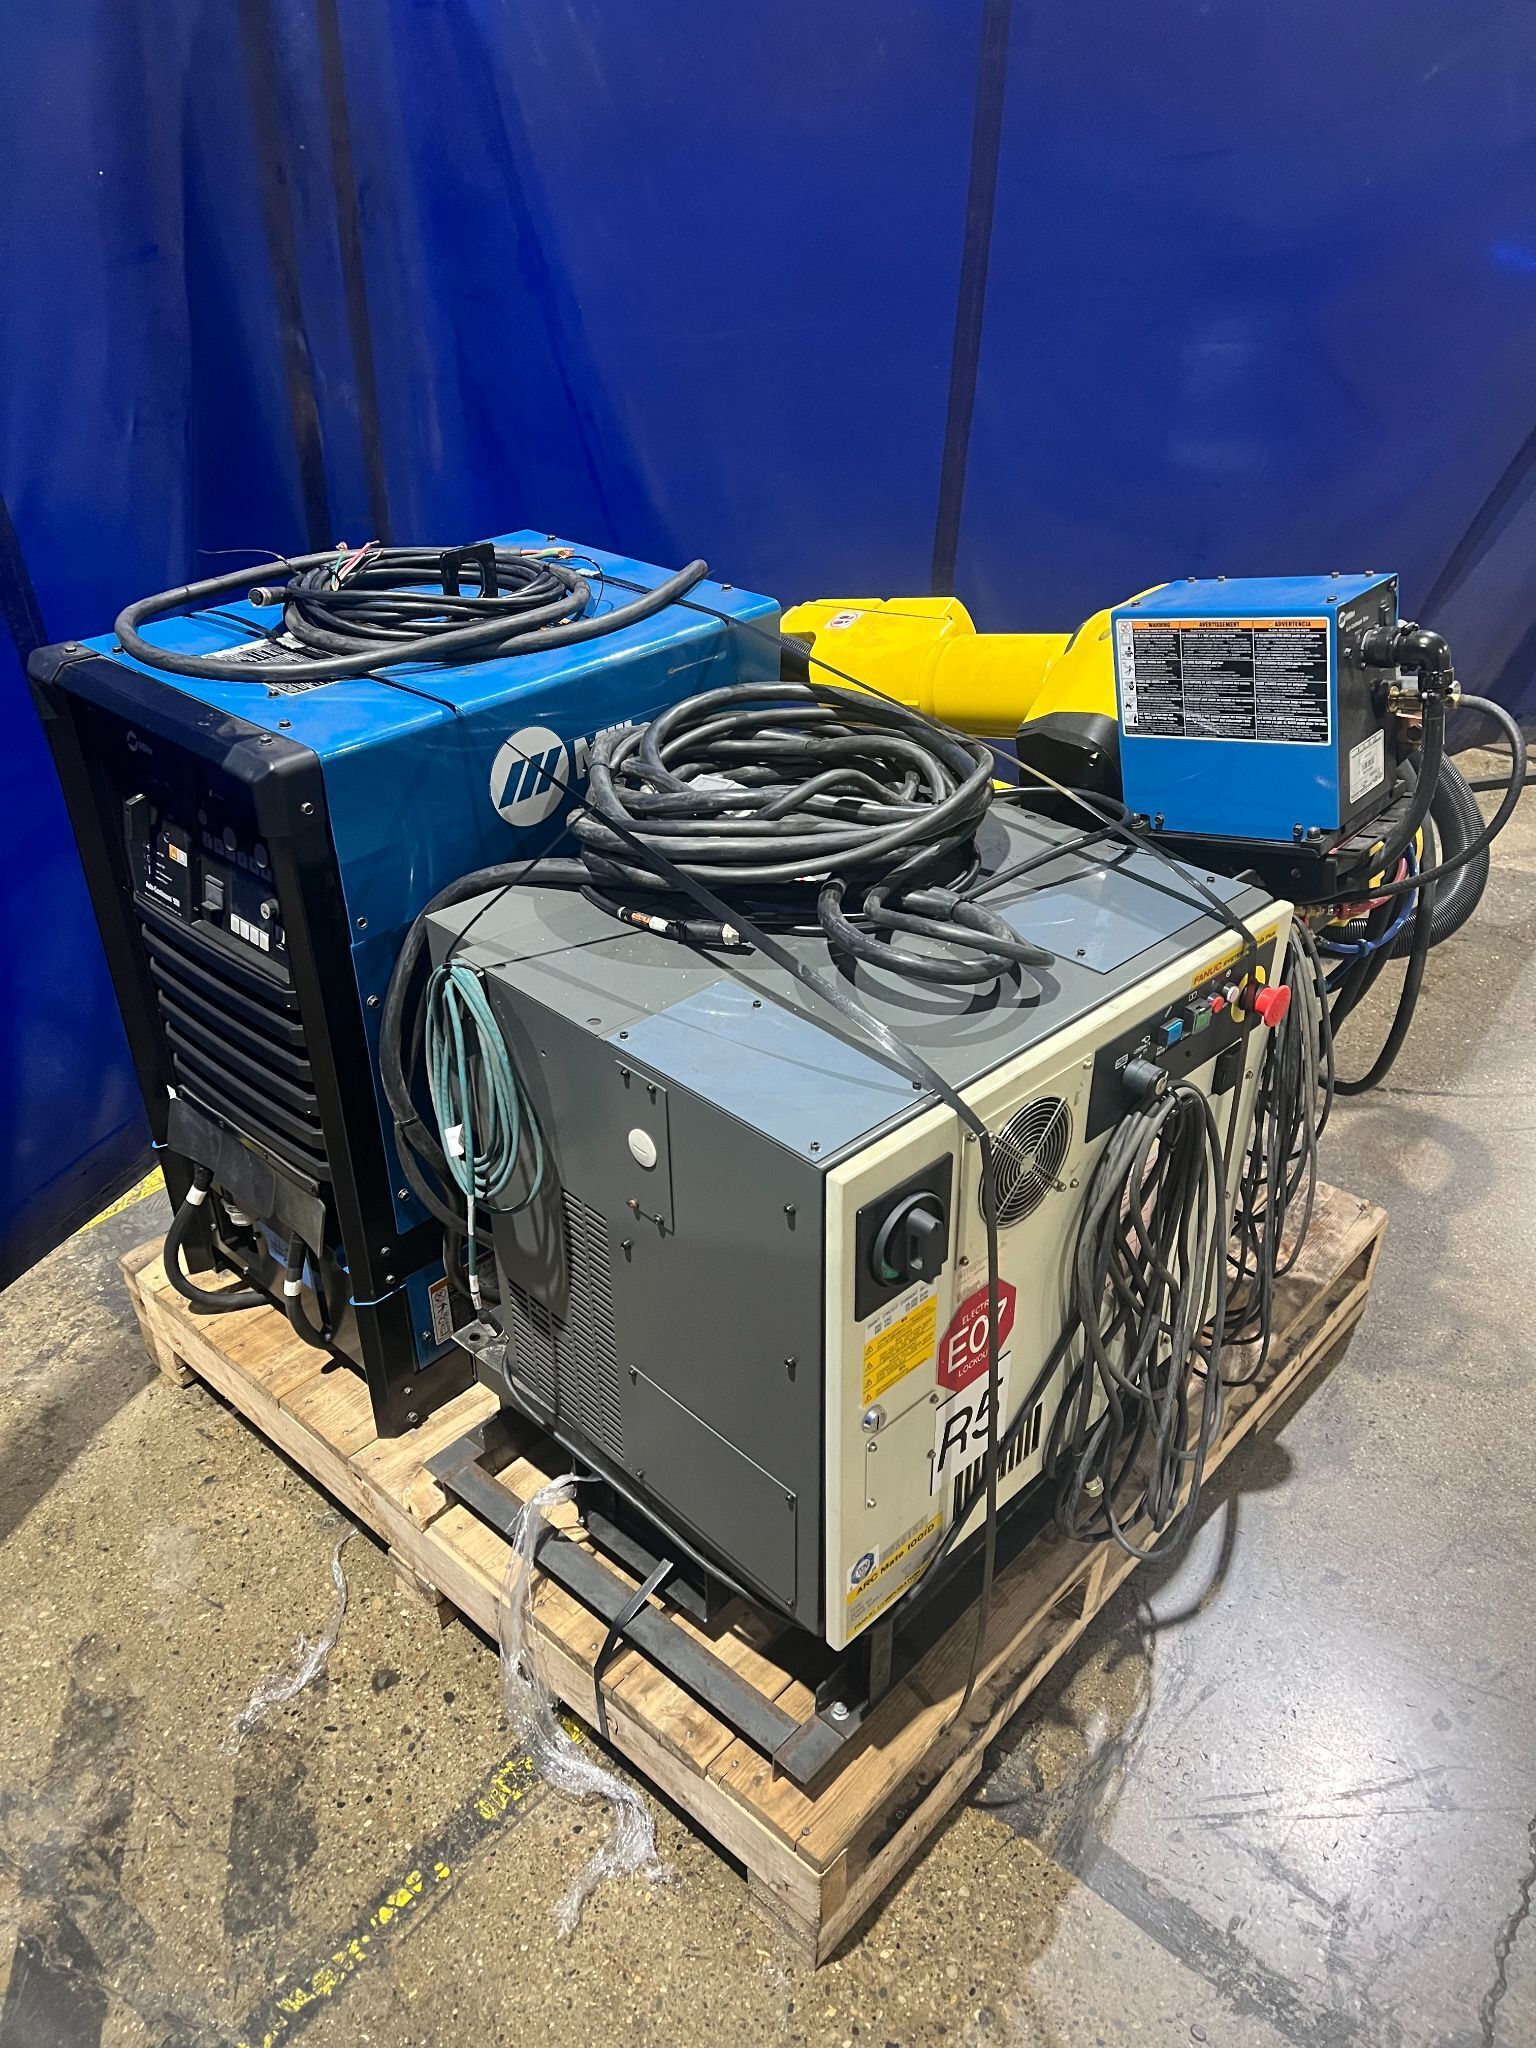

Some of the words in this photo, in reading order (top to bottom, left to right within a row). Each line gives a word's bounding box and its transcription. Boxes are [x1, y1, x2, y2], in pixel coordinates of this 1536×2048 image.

[1193, 961, 1222, 986] FANUC
[958, 1349, 989, 1377] LOCKOU
[856, 1573, 878, 1596] ARC
[880, 1551, 904, 1574] Mate
